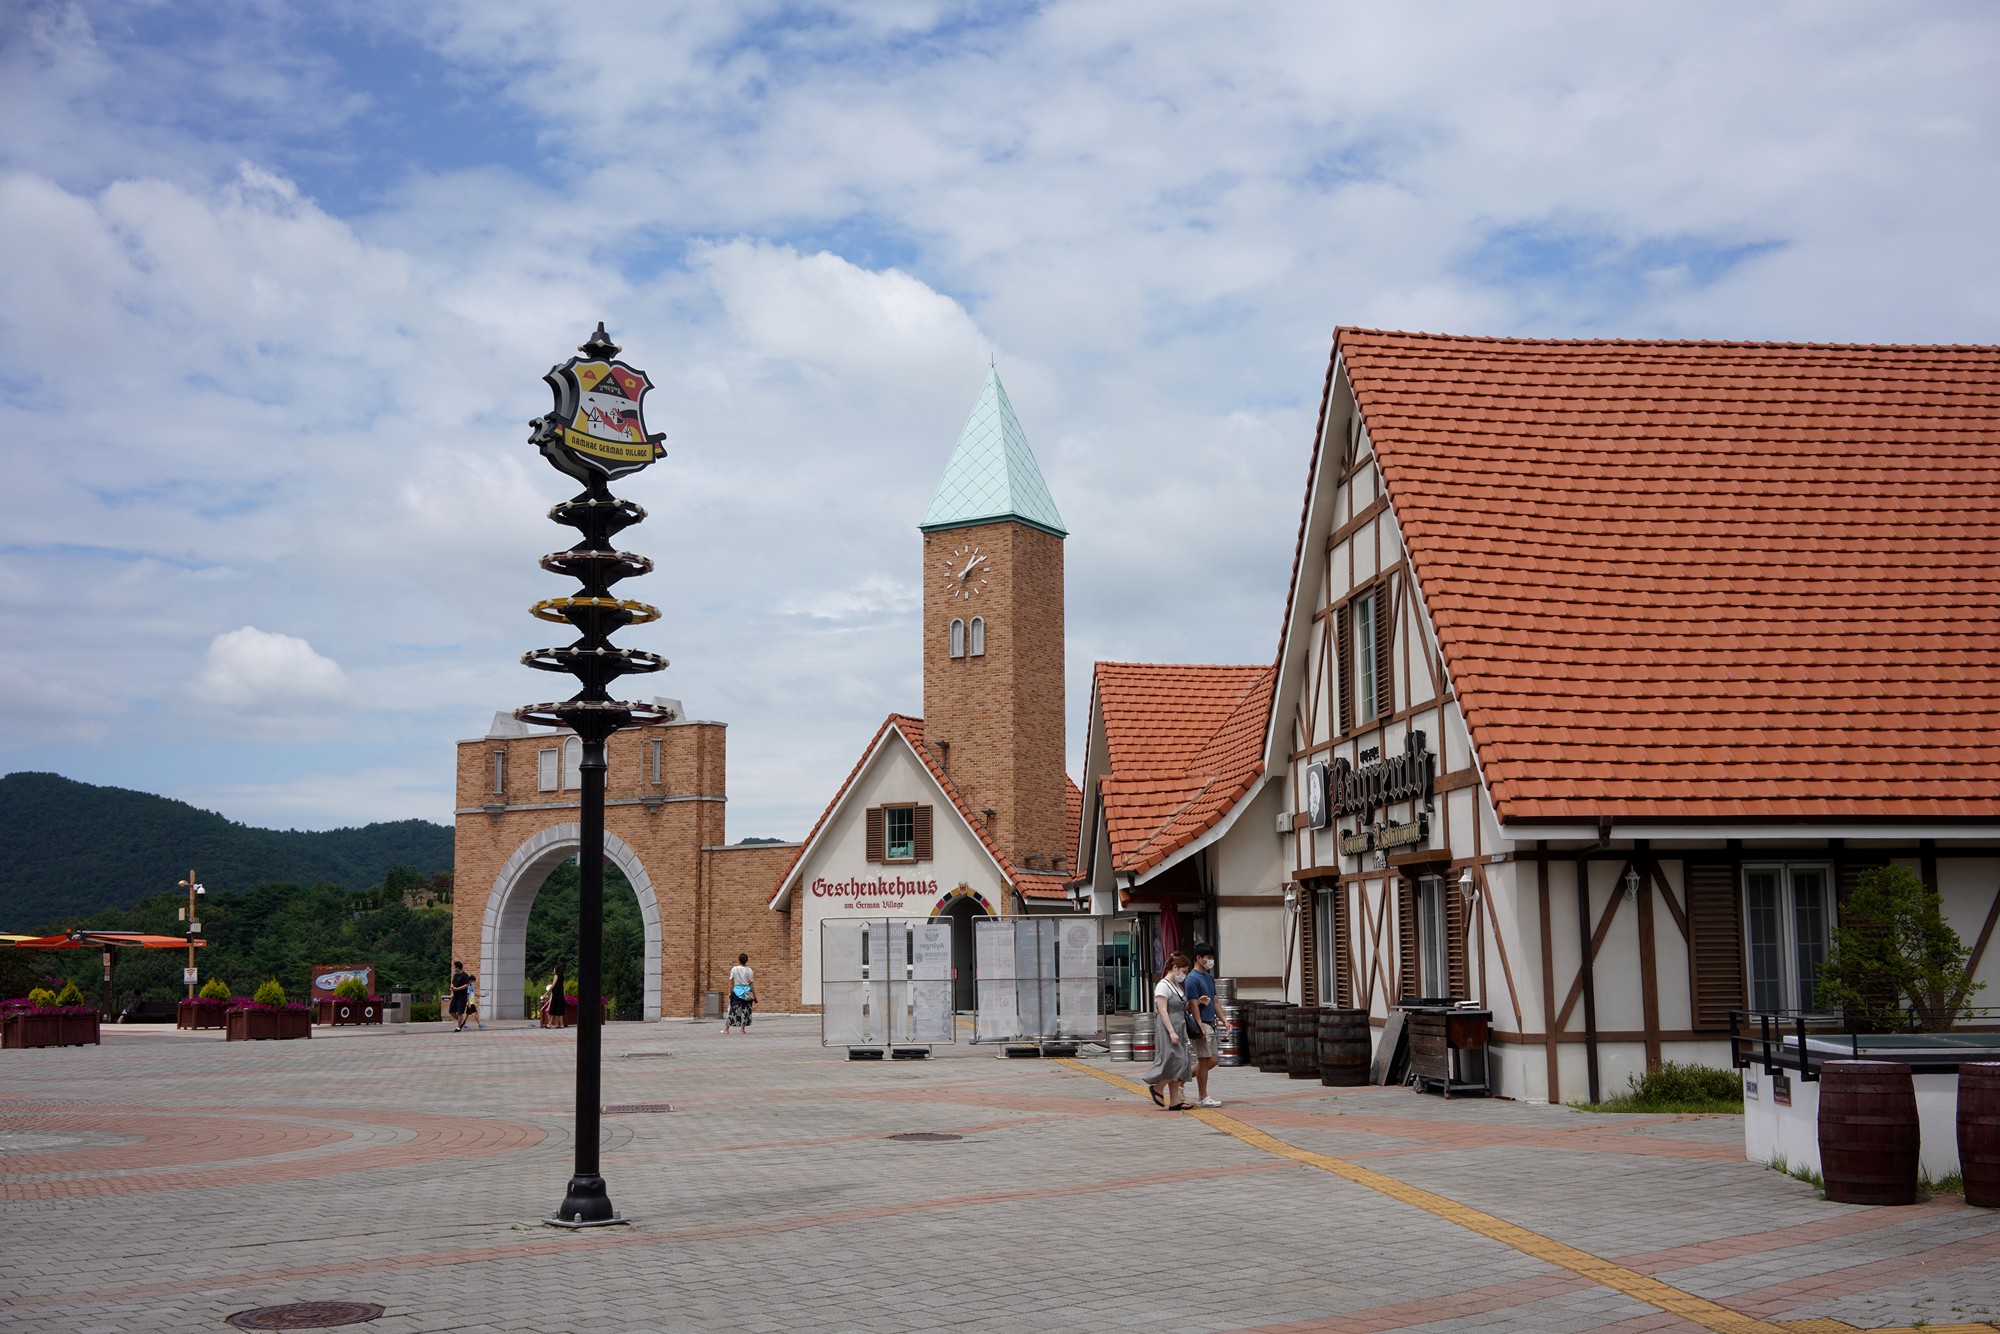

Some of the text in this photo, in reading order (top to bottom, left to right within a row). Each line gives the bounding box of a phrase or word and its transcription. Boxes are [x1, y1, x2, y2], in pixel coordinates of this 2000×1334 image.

[571, 435, 648, 457] NAMHAE GERMAN VILLAGE
[1327, 730, 1432, 826] Bayreuth
[811, 876, 938, 900] Geschenkehaus
[855, 901, 881, 909] German
[882, 901, 904, 909] Village
